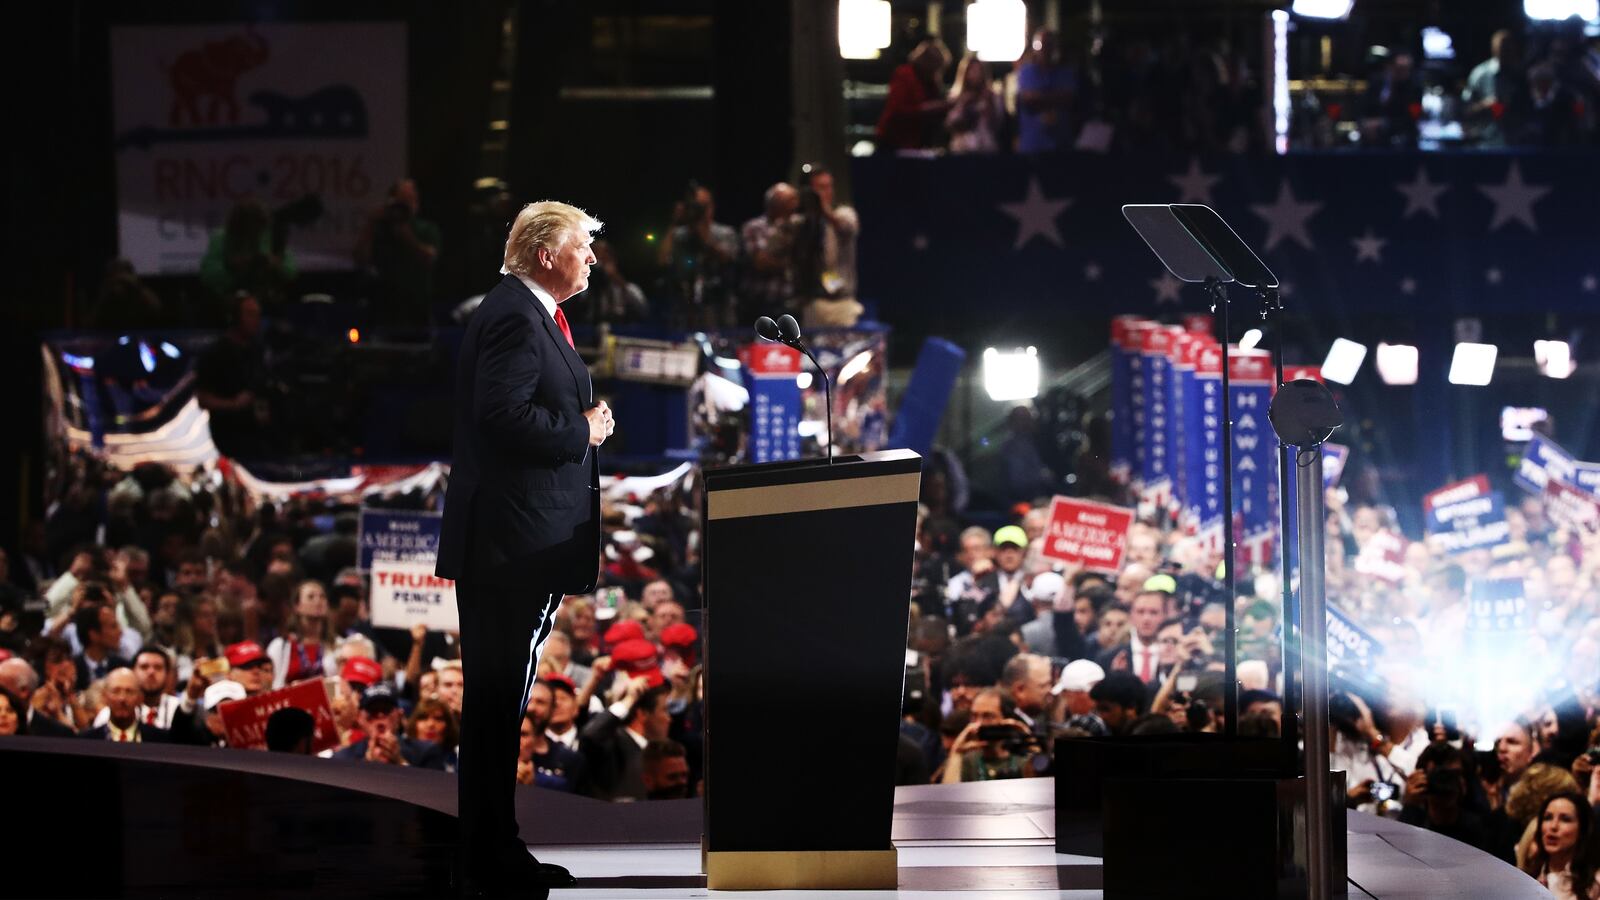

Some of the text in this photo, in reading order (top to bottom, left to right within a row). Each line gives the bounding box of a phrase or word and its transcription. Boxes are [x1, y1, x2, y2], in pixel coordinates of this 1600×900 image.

[154, 152, 371, 201] RNC 2016
[1203, 382, 1218, 511] KENTUCKY
[1235, 392, 1259, 513] HAWAII
[364, 533, 439, 549] AMERIC
[393, 591, 441, 604] PENCE
[254, 698, 290, 718] MAKE
